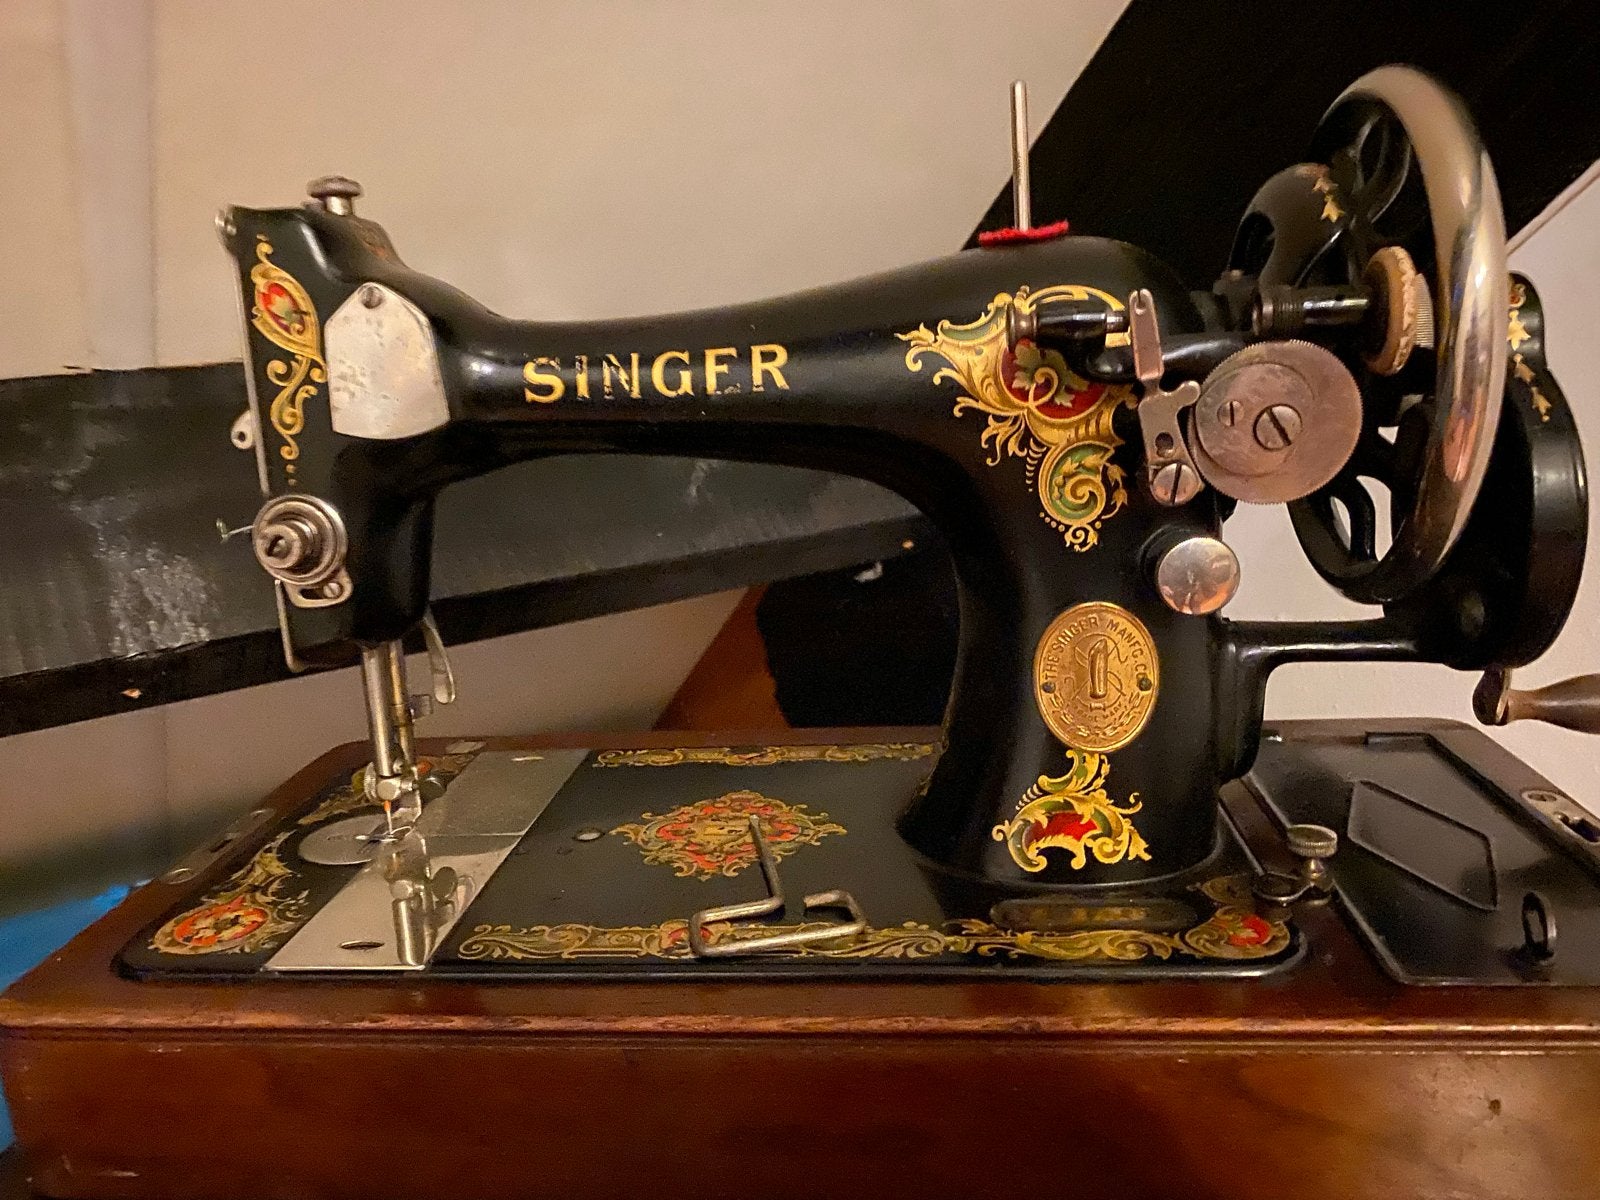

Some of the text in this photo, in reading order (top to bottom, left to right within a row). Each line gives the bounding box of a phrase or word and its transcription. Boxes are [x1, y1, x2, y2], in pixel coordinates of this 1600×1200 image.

[522, 343, 790, 403] SINGER
[1044, 655, 1060, 680] THE
[1052, 613, 1099, 654] SINGER
